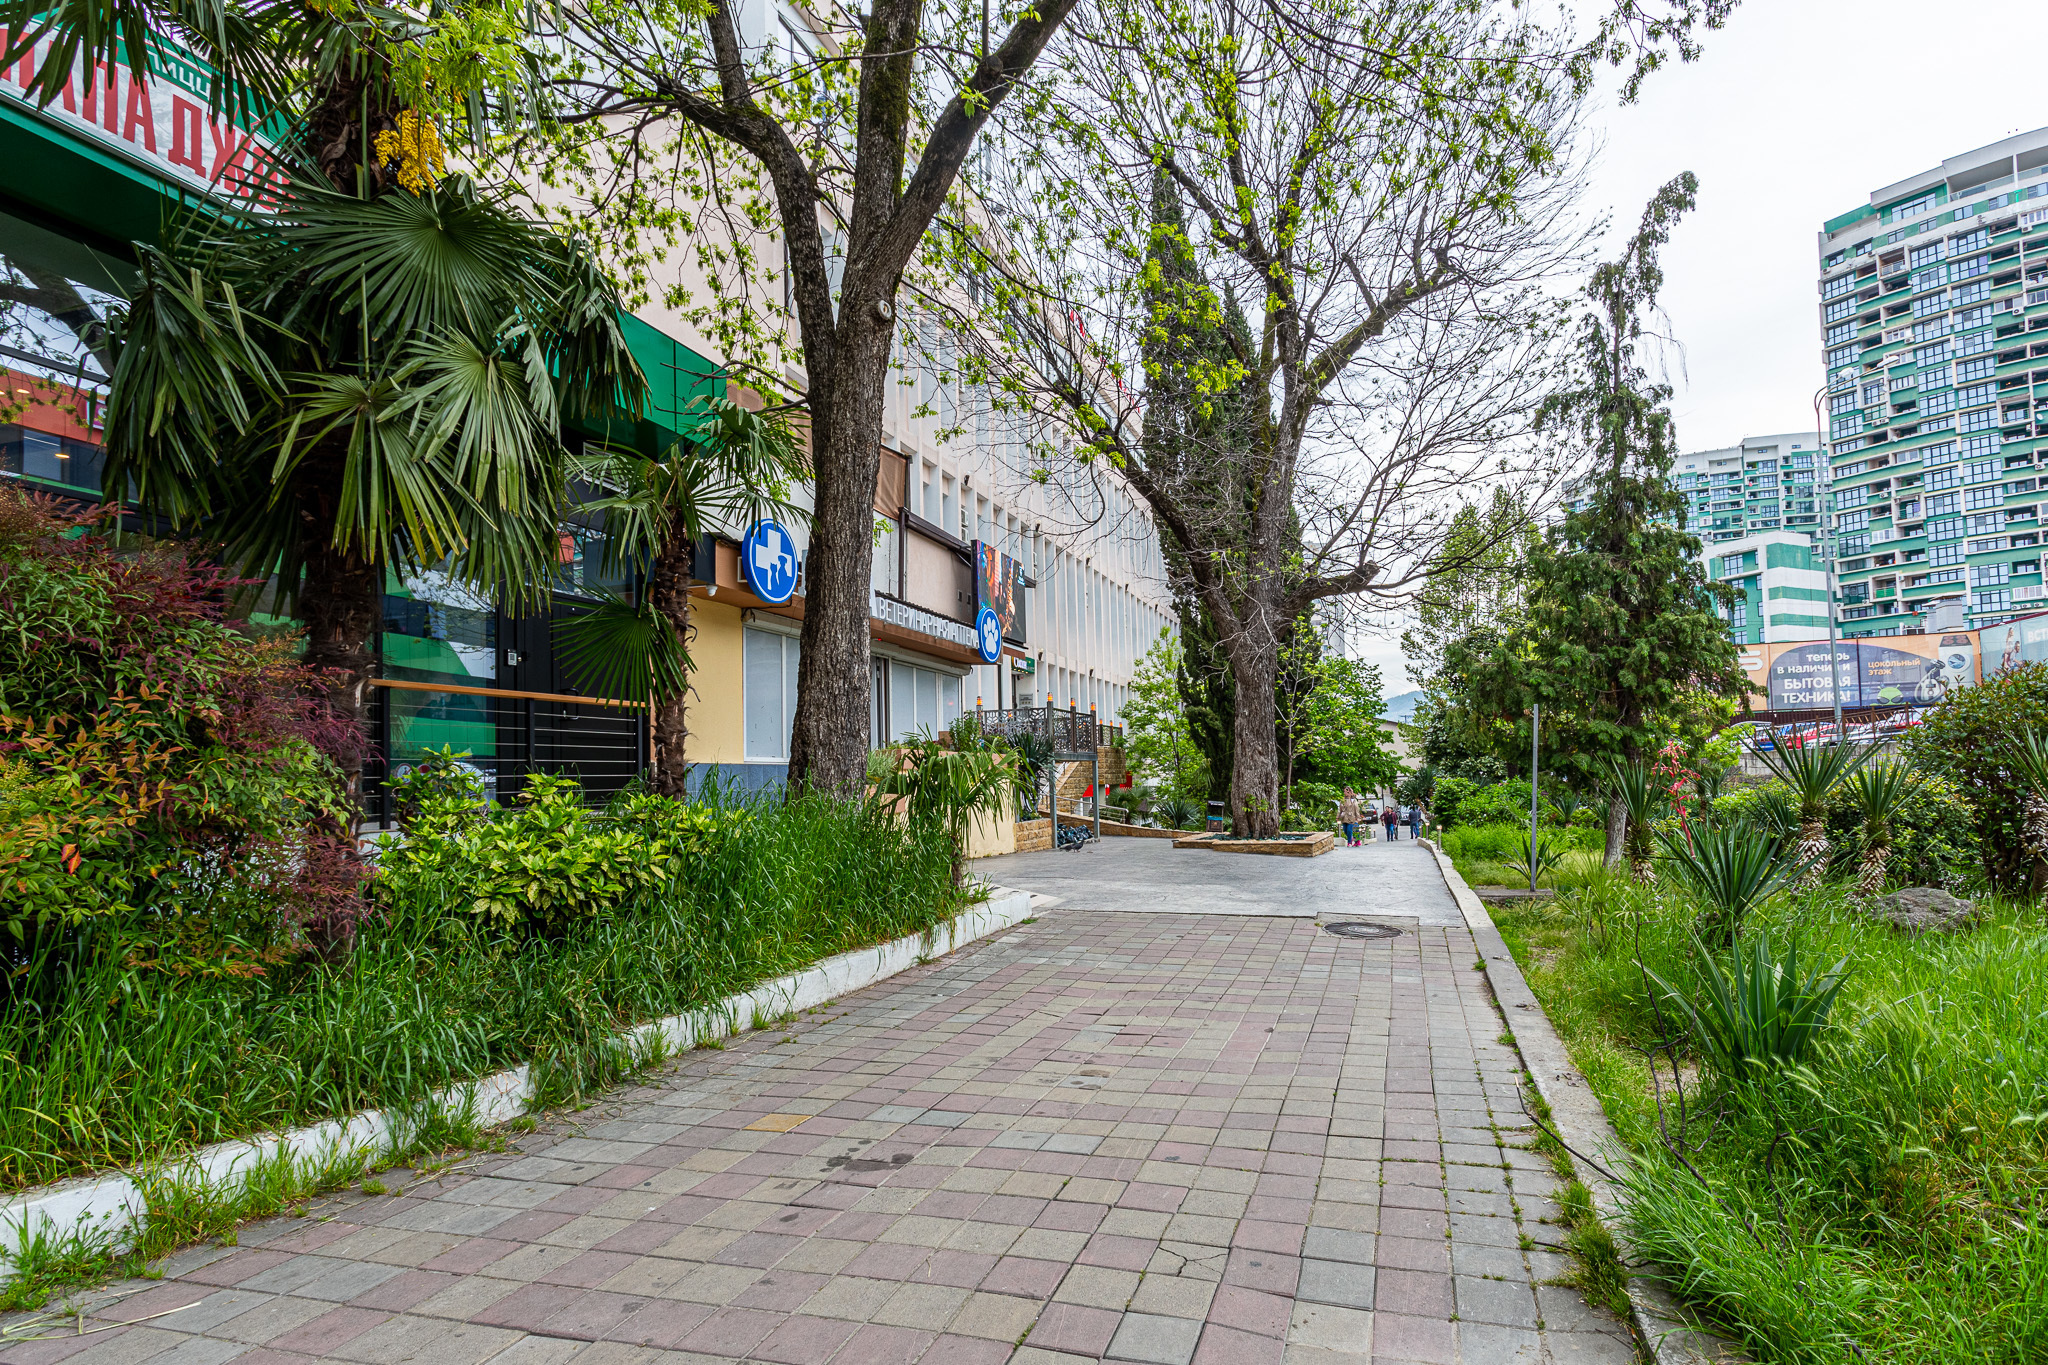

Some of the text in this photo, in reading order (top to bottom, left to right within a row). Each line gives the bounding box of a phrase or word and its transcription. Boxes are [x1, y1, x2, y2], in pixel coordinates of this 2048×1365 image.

[880, 597, 950, 638] ВЕТЕРИНАРНАЯ
[951, 622, 980, 649] АПТЕКА
[2027, 628, 2048, 642] ВСТ
[1777, 663, 1850, 674] в наличи и
[1868, 658, 1921, 669] цокольный
